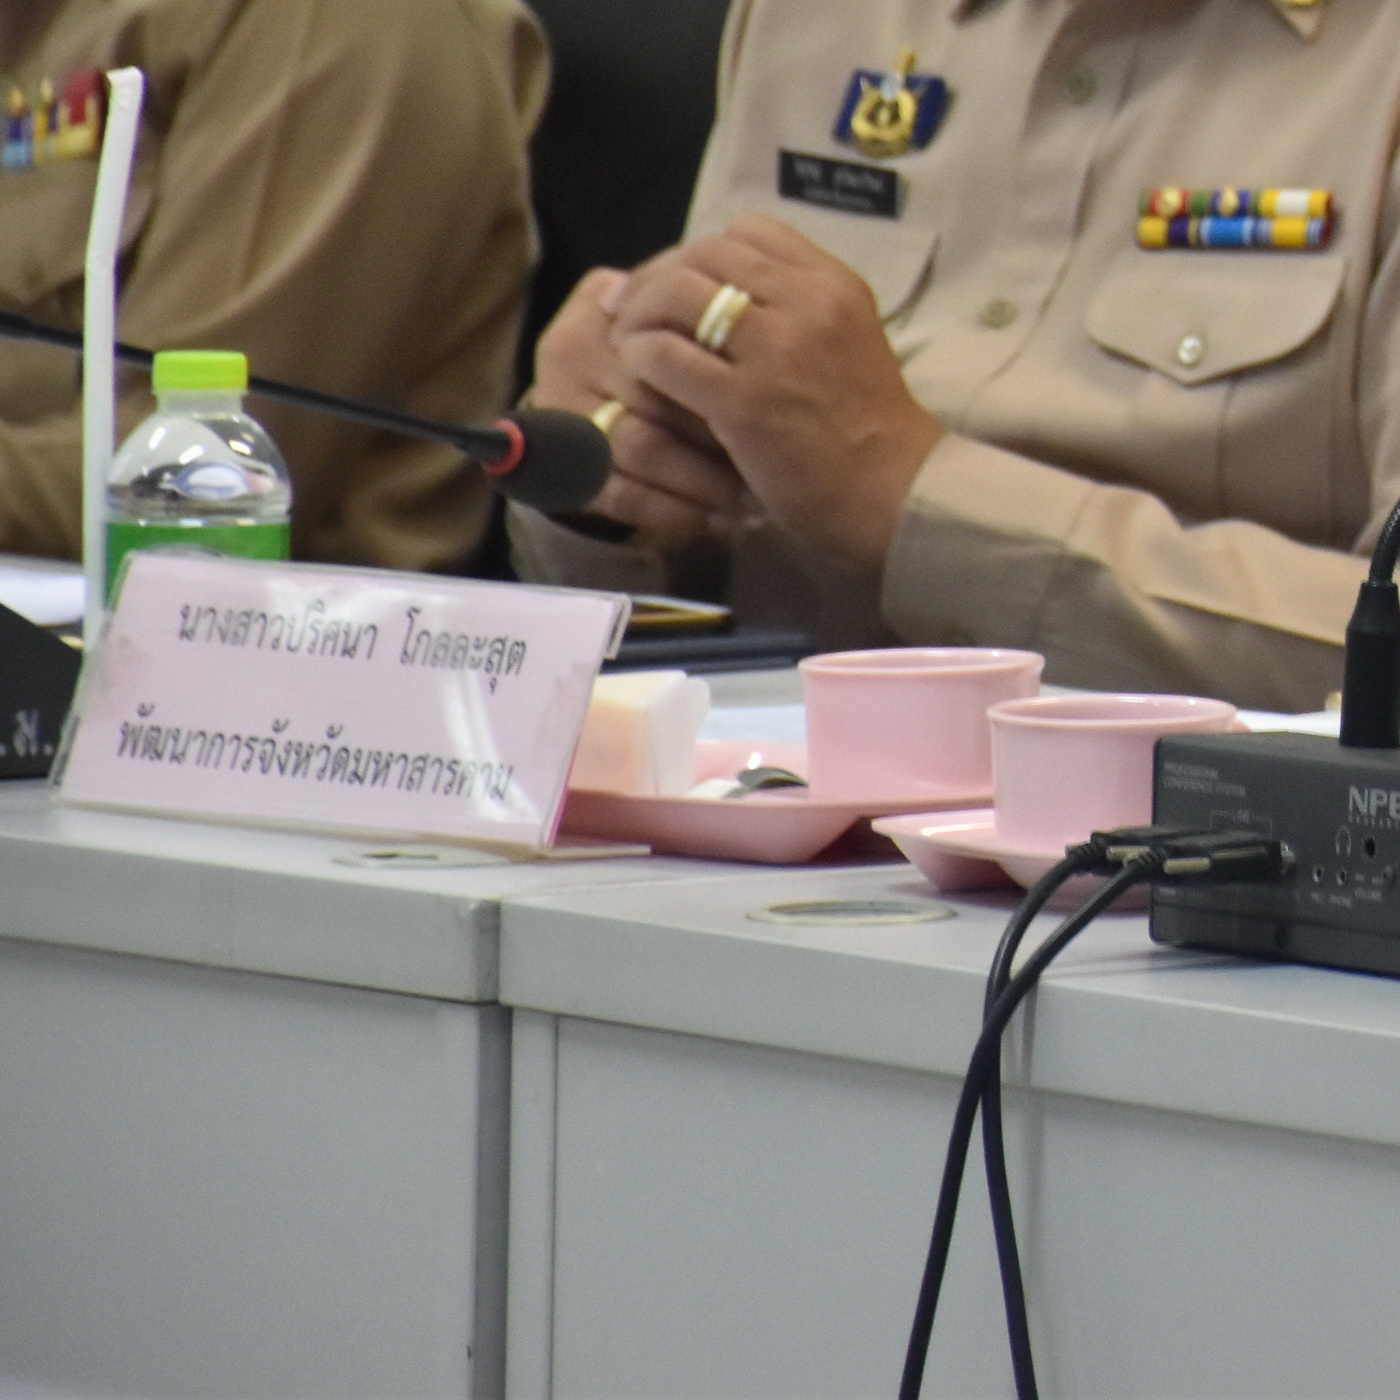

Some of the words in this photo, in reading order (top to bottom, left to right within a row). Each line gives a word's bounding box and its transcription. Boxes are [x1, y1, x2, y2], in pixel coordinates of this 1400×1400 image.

[178, 598, 379, 660] นางสาวปริศนา
[117, 702, 514, 801] พัฒนาการจังหวัดมหาสารคาม
